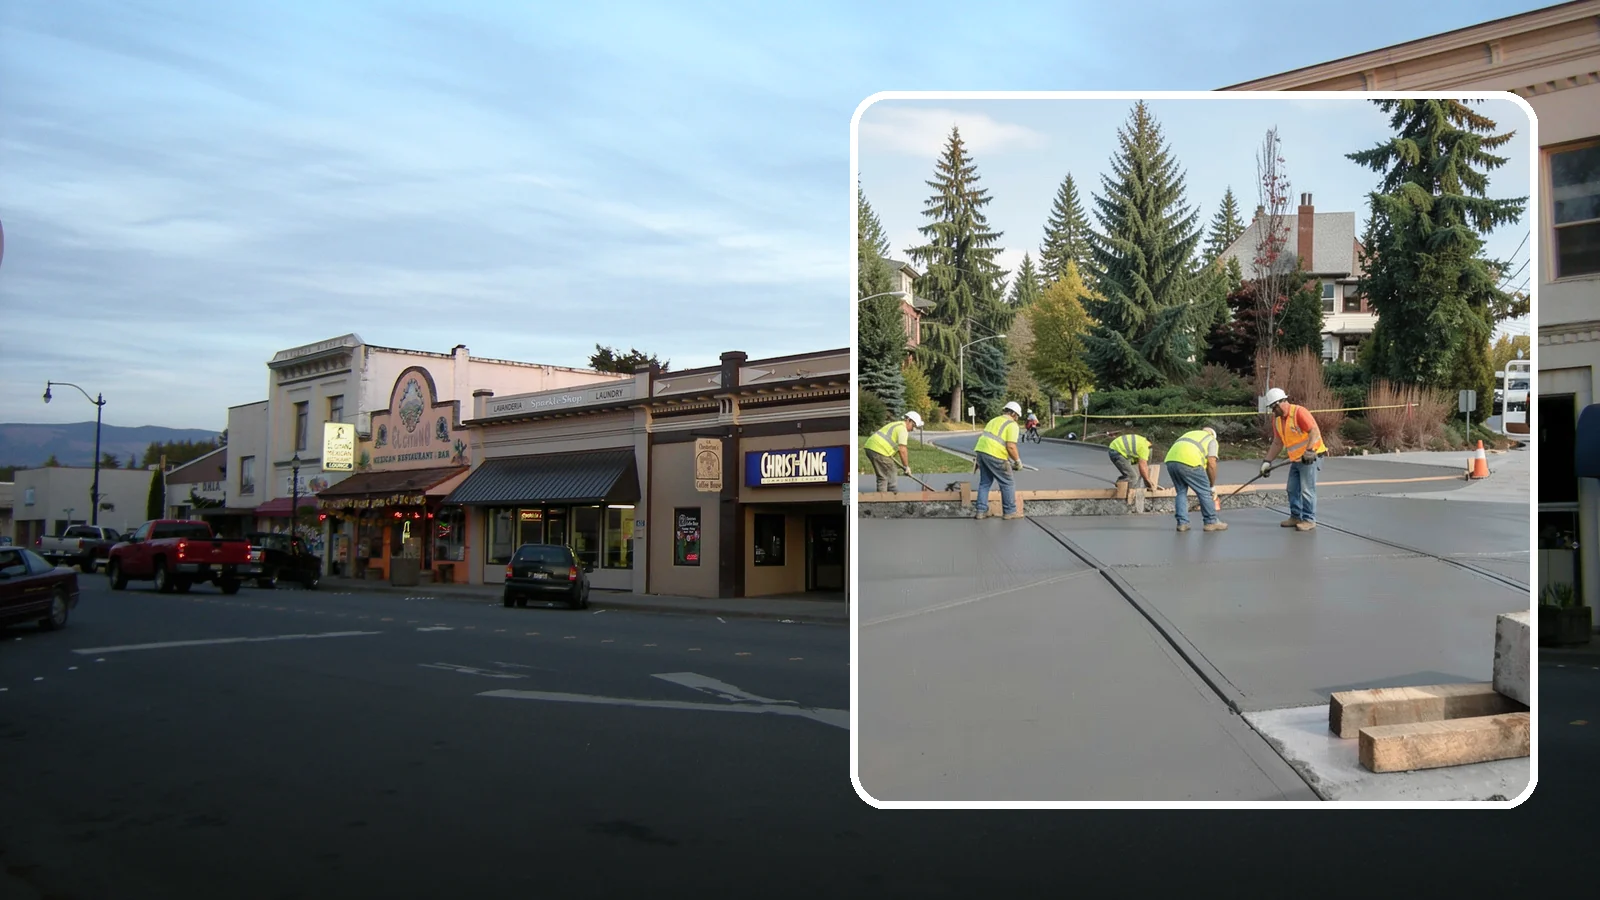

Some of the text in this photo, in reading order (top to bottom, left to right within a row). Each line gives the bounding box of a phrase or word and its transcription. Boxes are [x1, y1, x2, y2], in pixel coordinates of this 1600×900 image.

[562, 394, 582, 404] Shop
[596, 389, 623, 399] LAUNDRY
[493, 402, 522, 412] LAVANDERIA
[373, 450, 450, 464] MEXICAN RESTAURANT BAR
[761, 450, 827, 478] CHRIST KING
[697, 480, 721, 489] Coffee House
